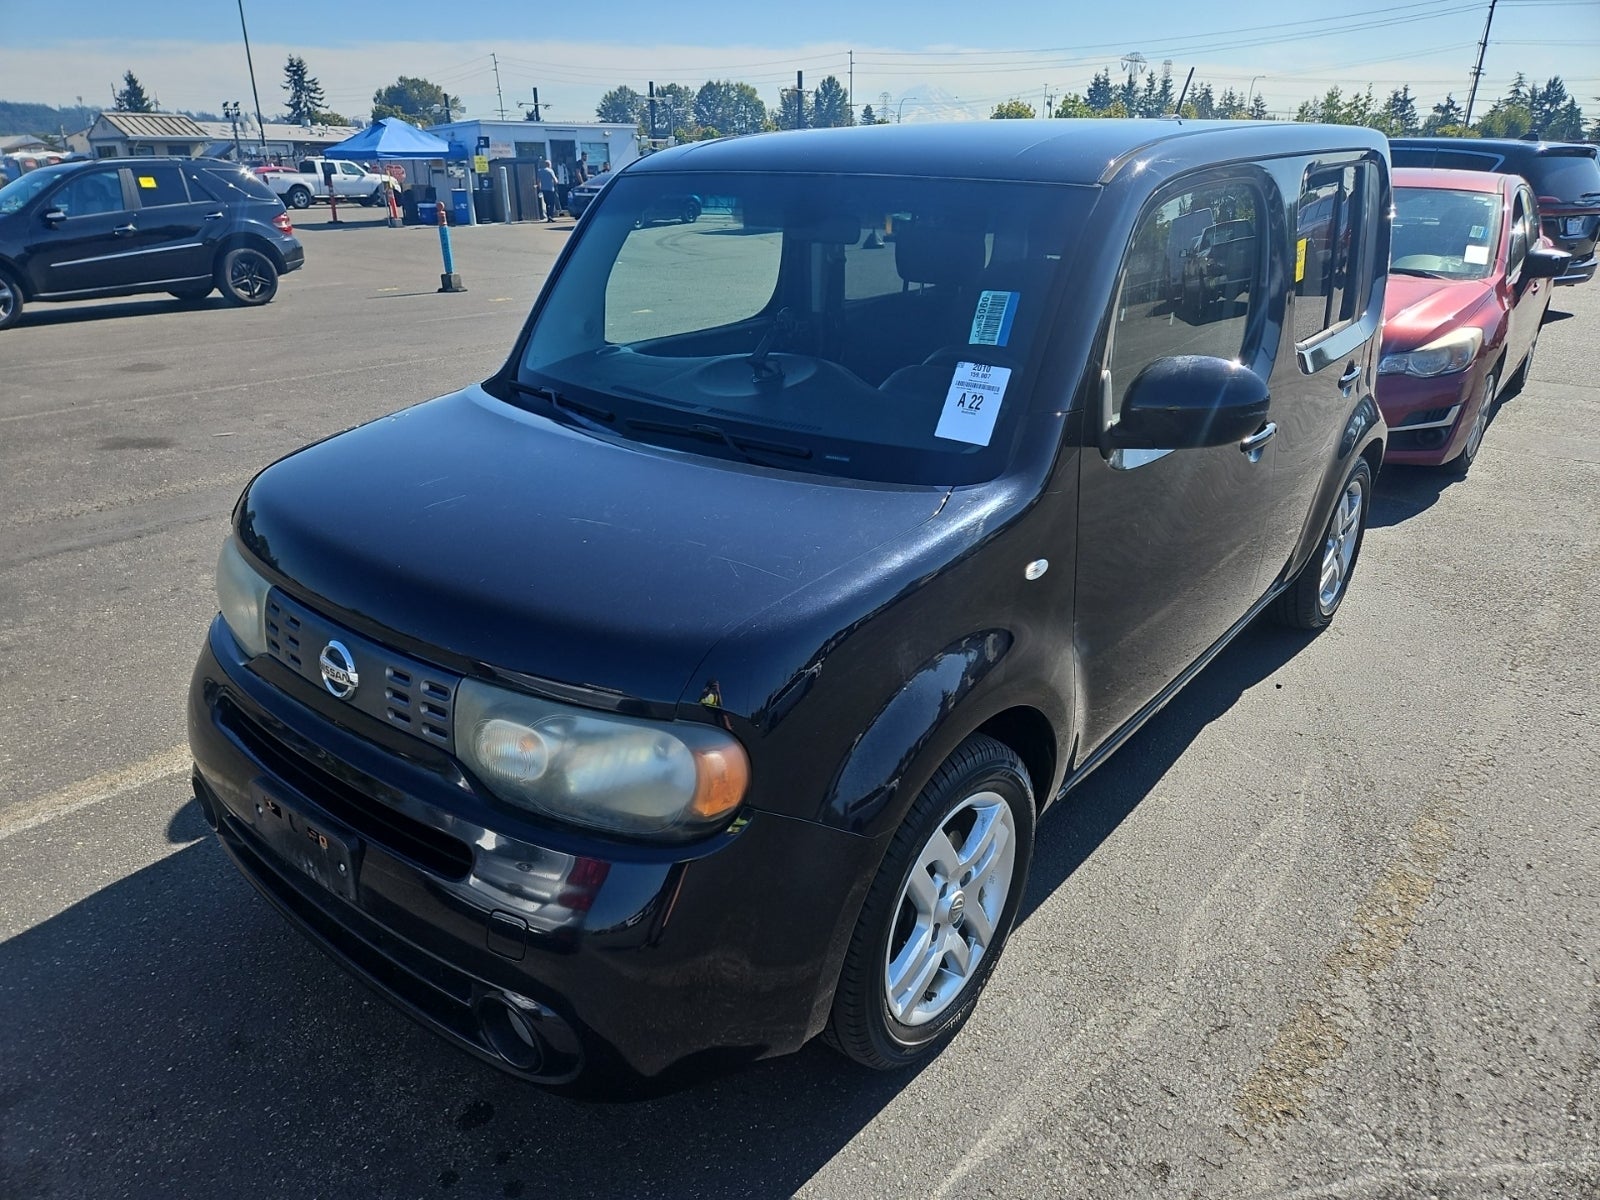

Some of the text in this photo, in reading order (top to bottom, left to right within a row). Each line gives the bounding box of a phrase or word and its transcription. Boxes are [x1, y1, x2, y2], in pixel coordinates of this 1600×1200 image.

[972, 364, 992, 373] 2010
[957, 392, 984, 411] A 22
